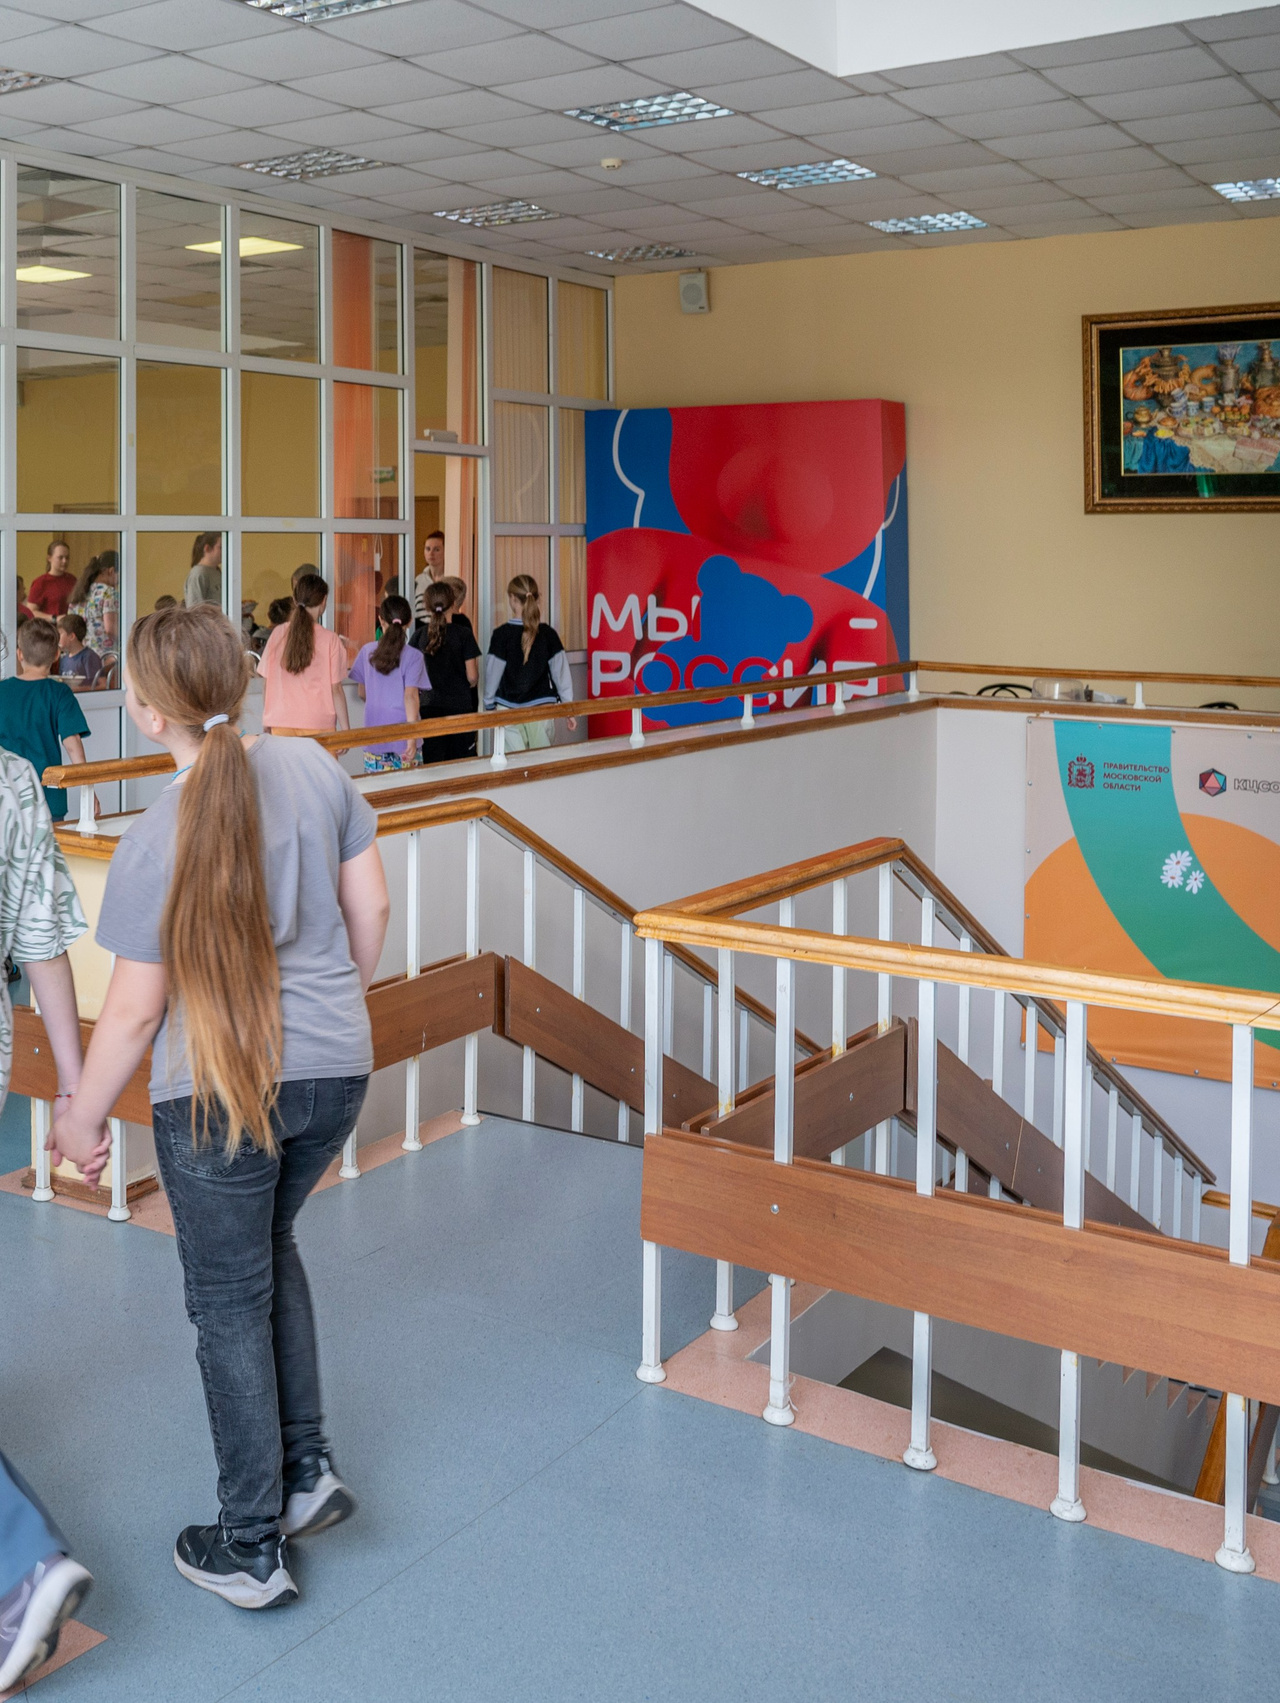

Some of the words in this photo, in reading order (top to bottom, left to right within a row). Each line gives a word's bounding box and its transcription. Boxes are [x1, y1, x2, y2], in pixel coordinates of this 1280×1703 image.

[591, 593, 701, 642] МЫ
[1103, 762, 1170, 774] ПРАВИТЕЛЬСТВО
[1103, 772, 1162, 783] МОСКОВСКОЙ
[1103, 782, 1141, 792] ОБЛАСТИ
